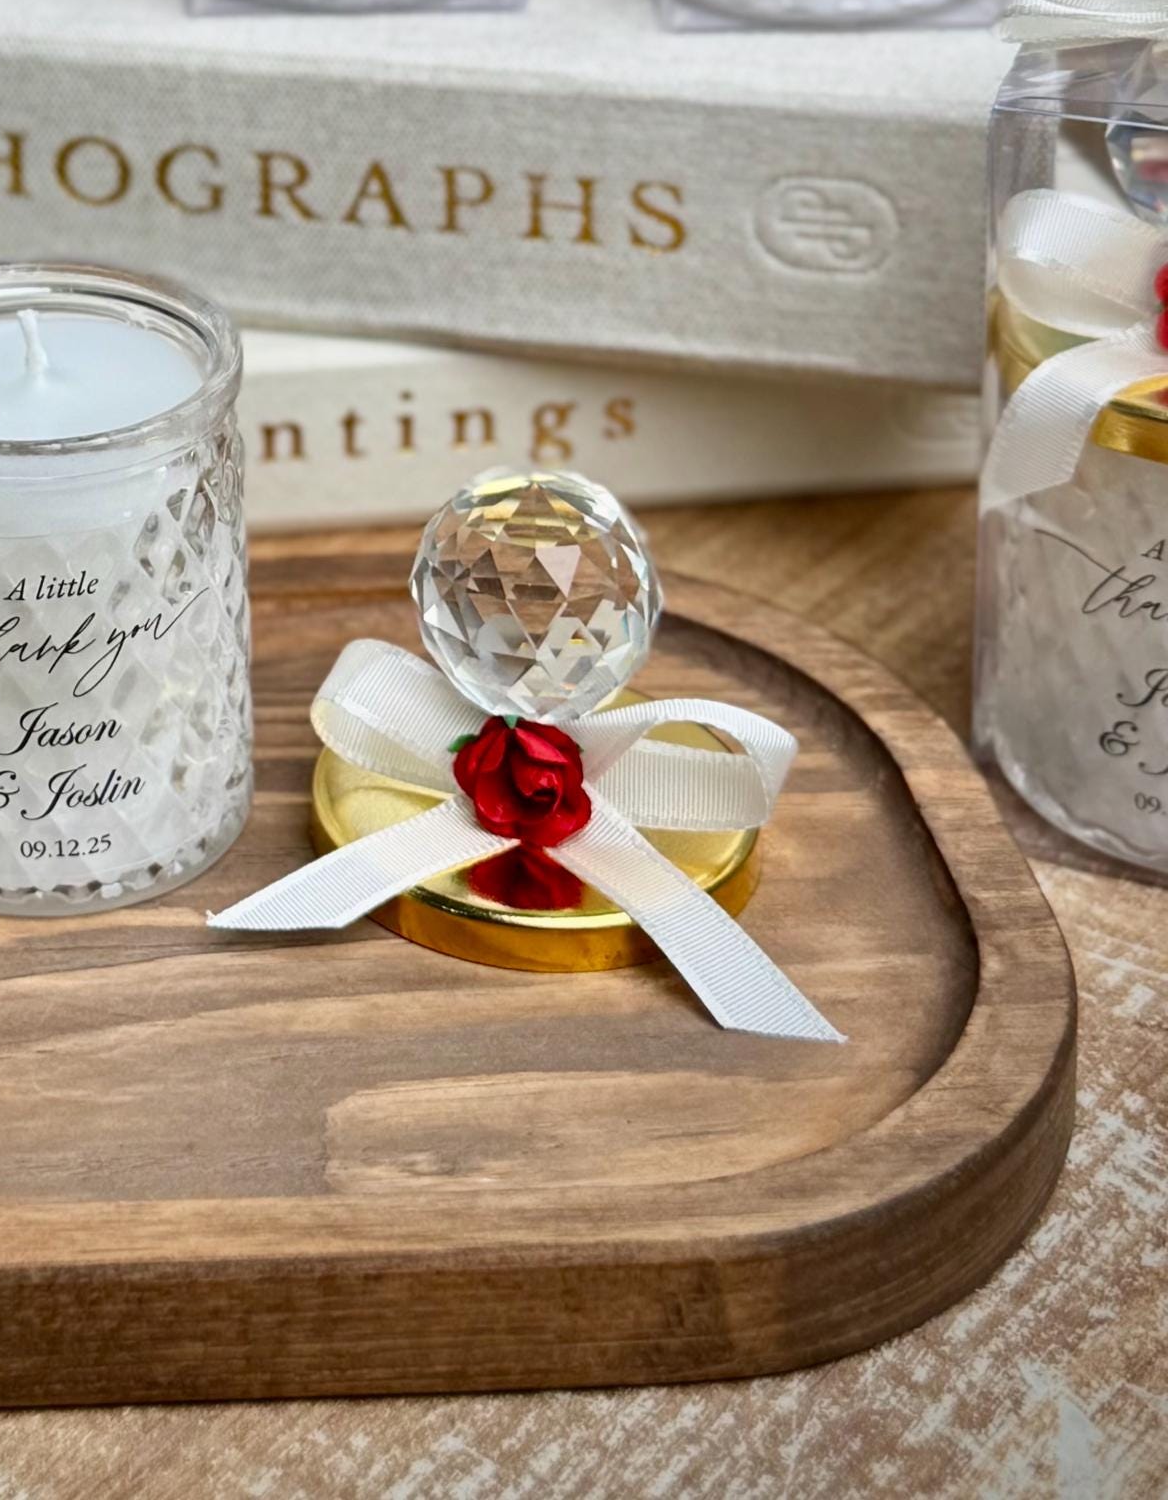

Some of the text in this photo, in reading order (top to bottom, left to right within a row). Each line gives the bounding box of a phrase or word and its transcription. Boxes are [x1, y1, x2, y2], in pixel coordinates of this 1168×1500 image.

[259, 392, 638, 464] ntings
[1139, 538, 1166, 562] A
[3, 570, 100, 602] A little
[72, 586, 210, 698] you
[1099, 719, 1141, 757] &
[19, 763, 146, 822] Joslin
[19, 833, 113, 860] 09.12.25
